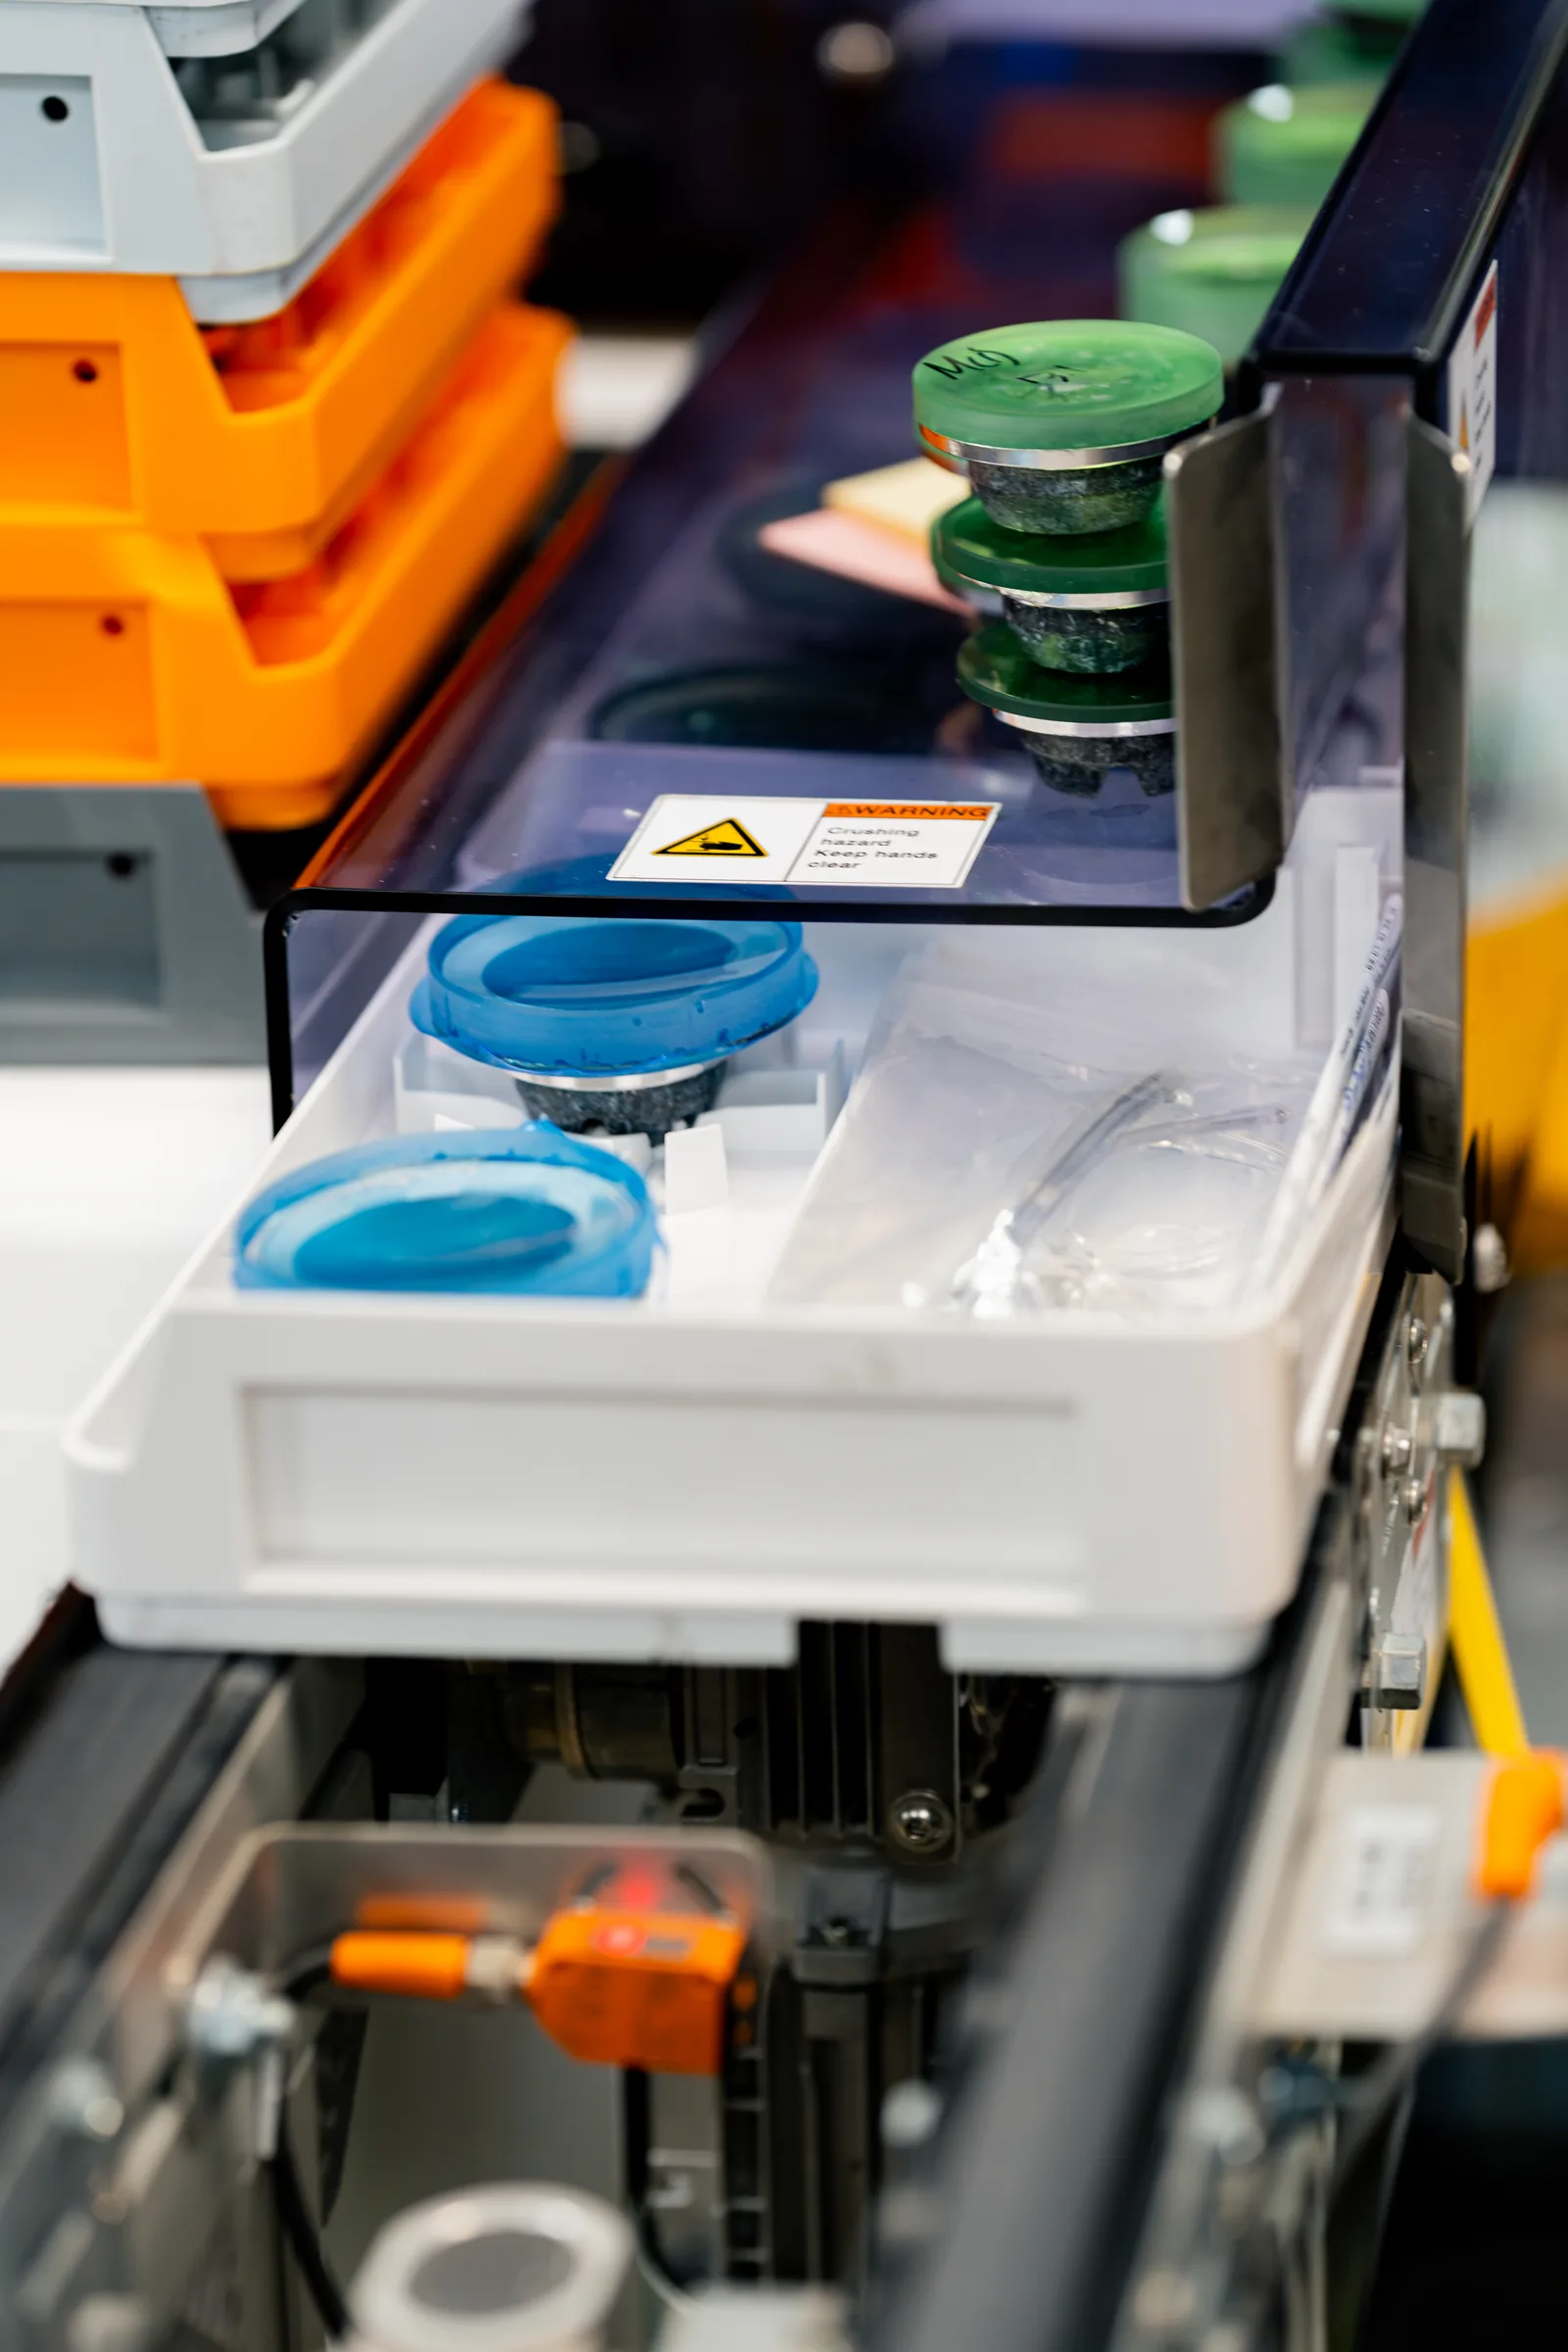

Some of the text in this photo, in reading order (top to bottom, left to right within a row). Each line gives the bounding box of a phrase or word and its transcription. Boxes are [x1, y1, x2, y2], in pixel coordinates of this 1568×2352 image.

[854, 805, 989, 817] WARNING
[827, 826, 920, 838] Crushing
[819, 838, 893, 848] hazard
[813, 849, 939, 859] Keep hands
[808, 860, 861, 869] clear
